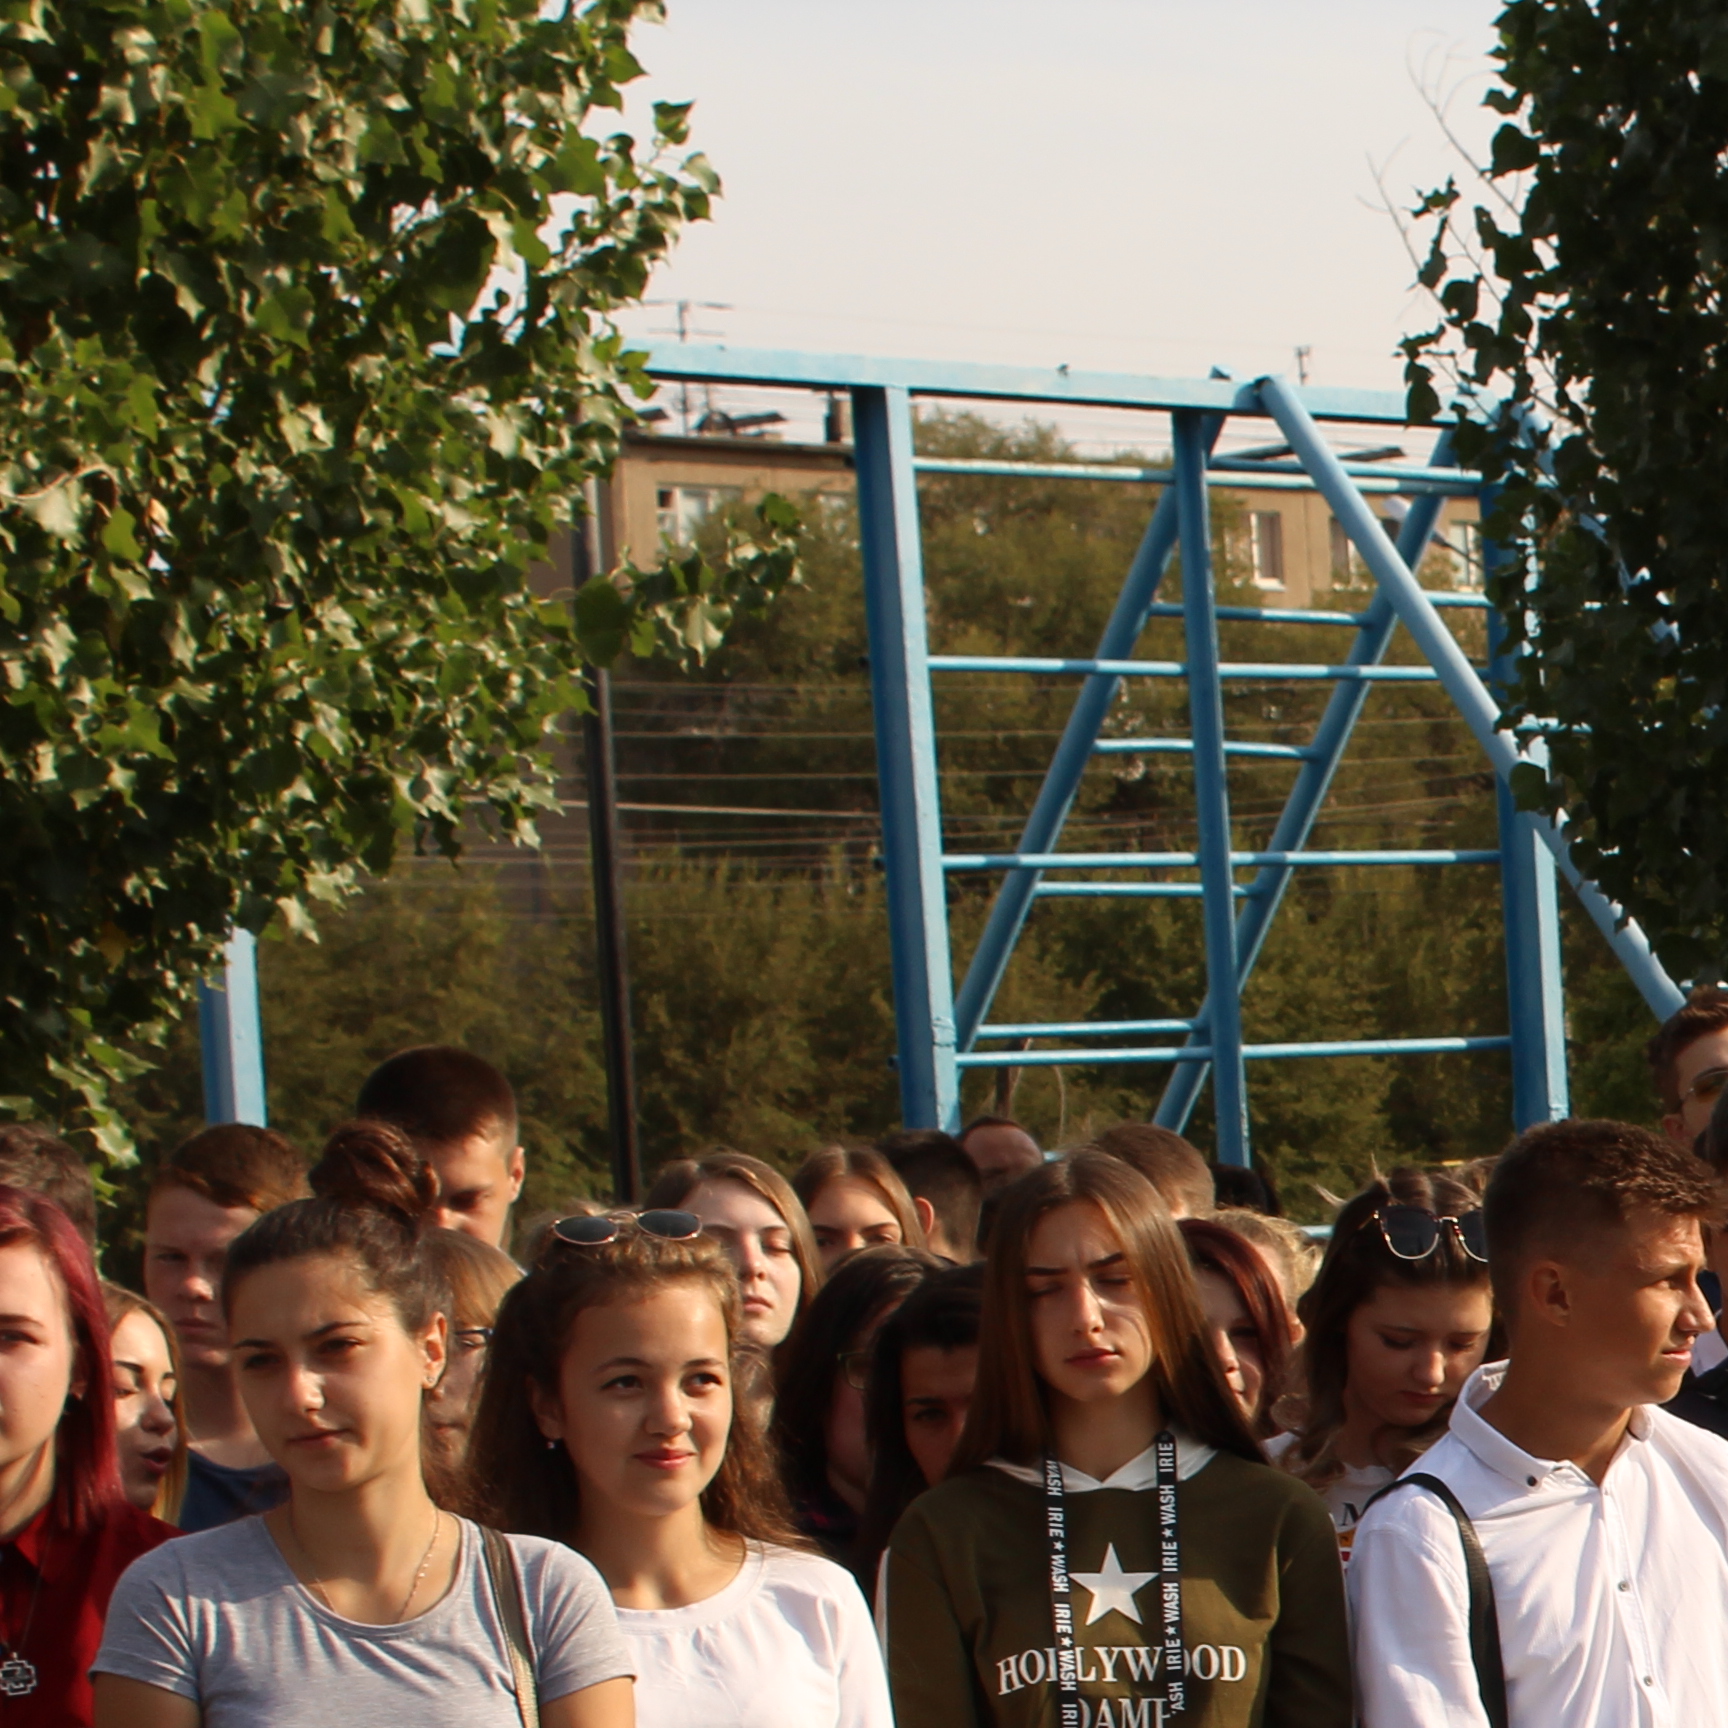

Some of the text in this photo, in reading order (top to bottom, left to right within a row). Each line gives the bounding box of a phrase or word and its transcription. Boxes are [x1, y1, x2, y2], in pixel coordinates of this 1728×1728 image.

[1045, 1459, 1063, 1496] WASH
[1047, 1507, 1065, 1539] IRIE
[1050, 1554, 1070, 1593] WASH
[1158, 1442, 1186, 1716] ASH IRIE WASH IRIE WASH IRIE
[1053, 1603, 1073, 1635] IRIE
[996, 1644, 1248, 1696] HOLLYWOD
[1058, 1650, 1077, 1691] WASH
